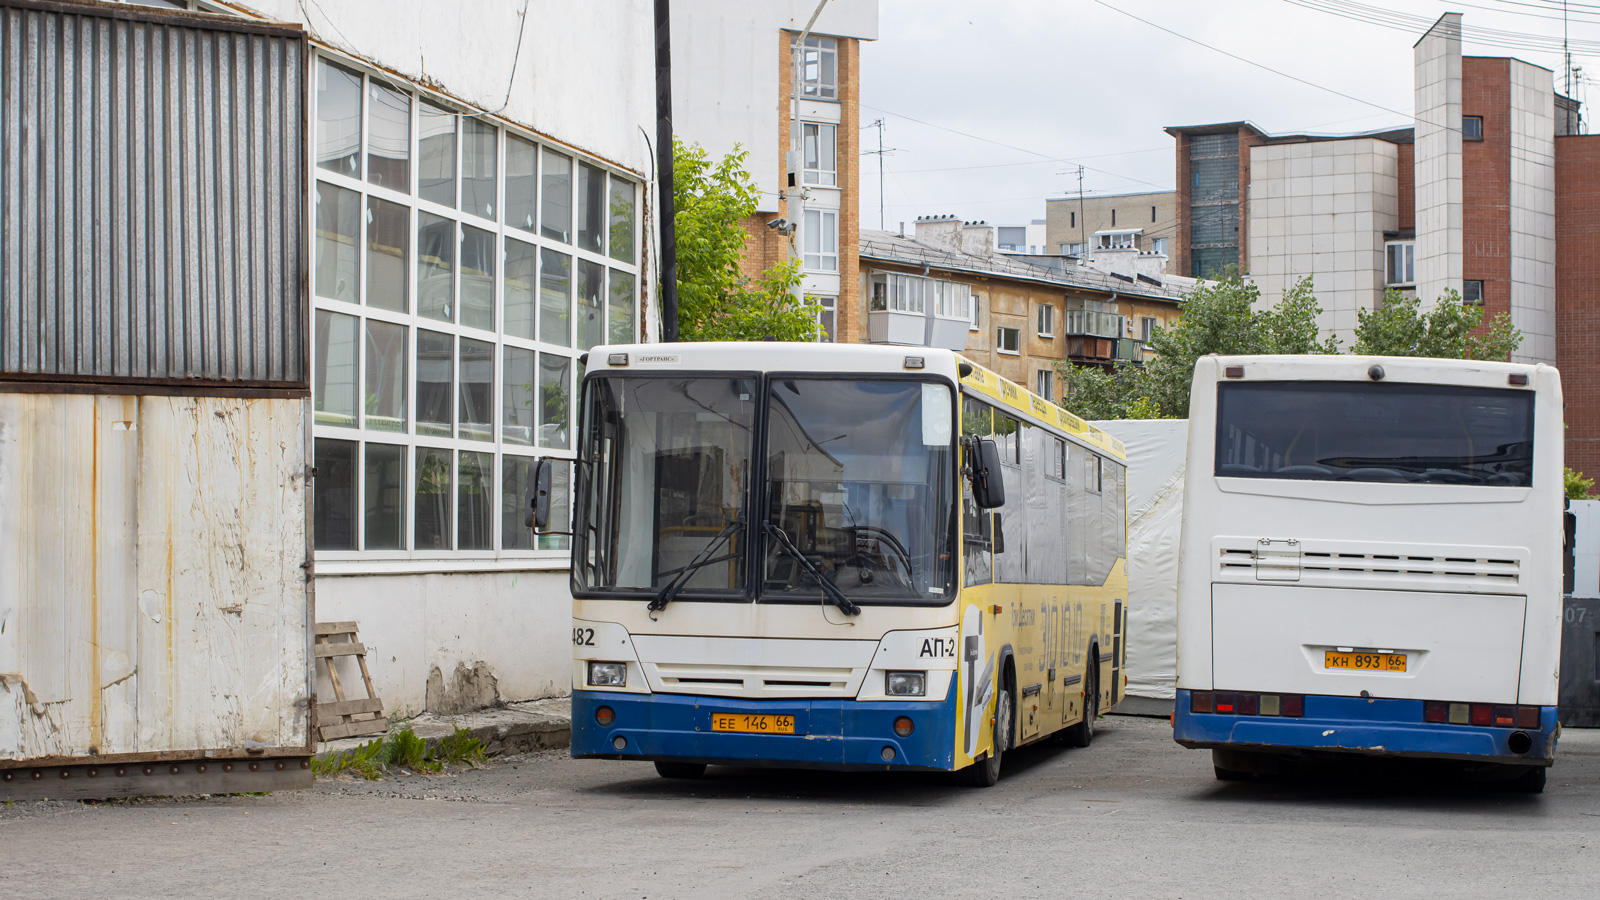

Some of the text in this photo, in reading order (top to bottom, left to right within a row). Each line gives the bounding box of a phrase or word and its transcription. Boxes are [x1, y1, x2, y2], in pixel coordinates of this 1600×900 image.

[919, 638, 955, 657] АП-2
[1332, 655, 1402, 668] КН 893 66
[719, 716, 790, 730] ЕЕ 146 66
